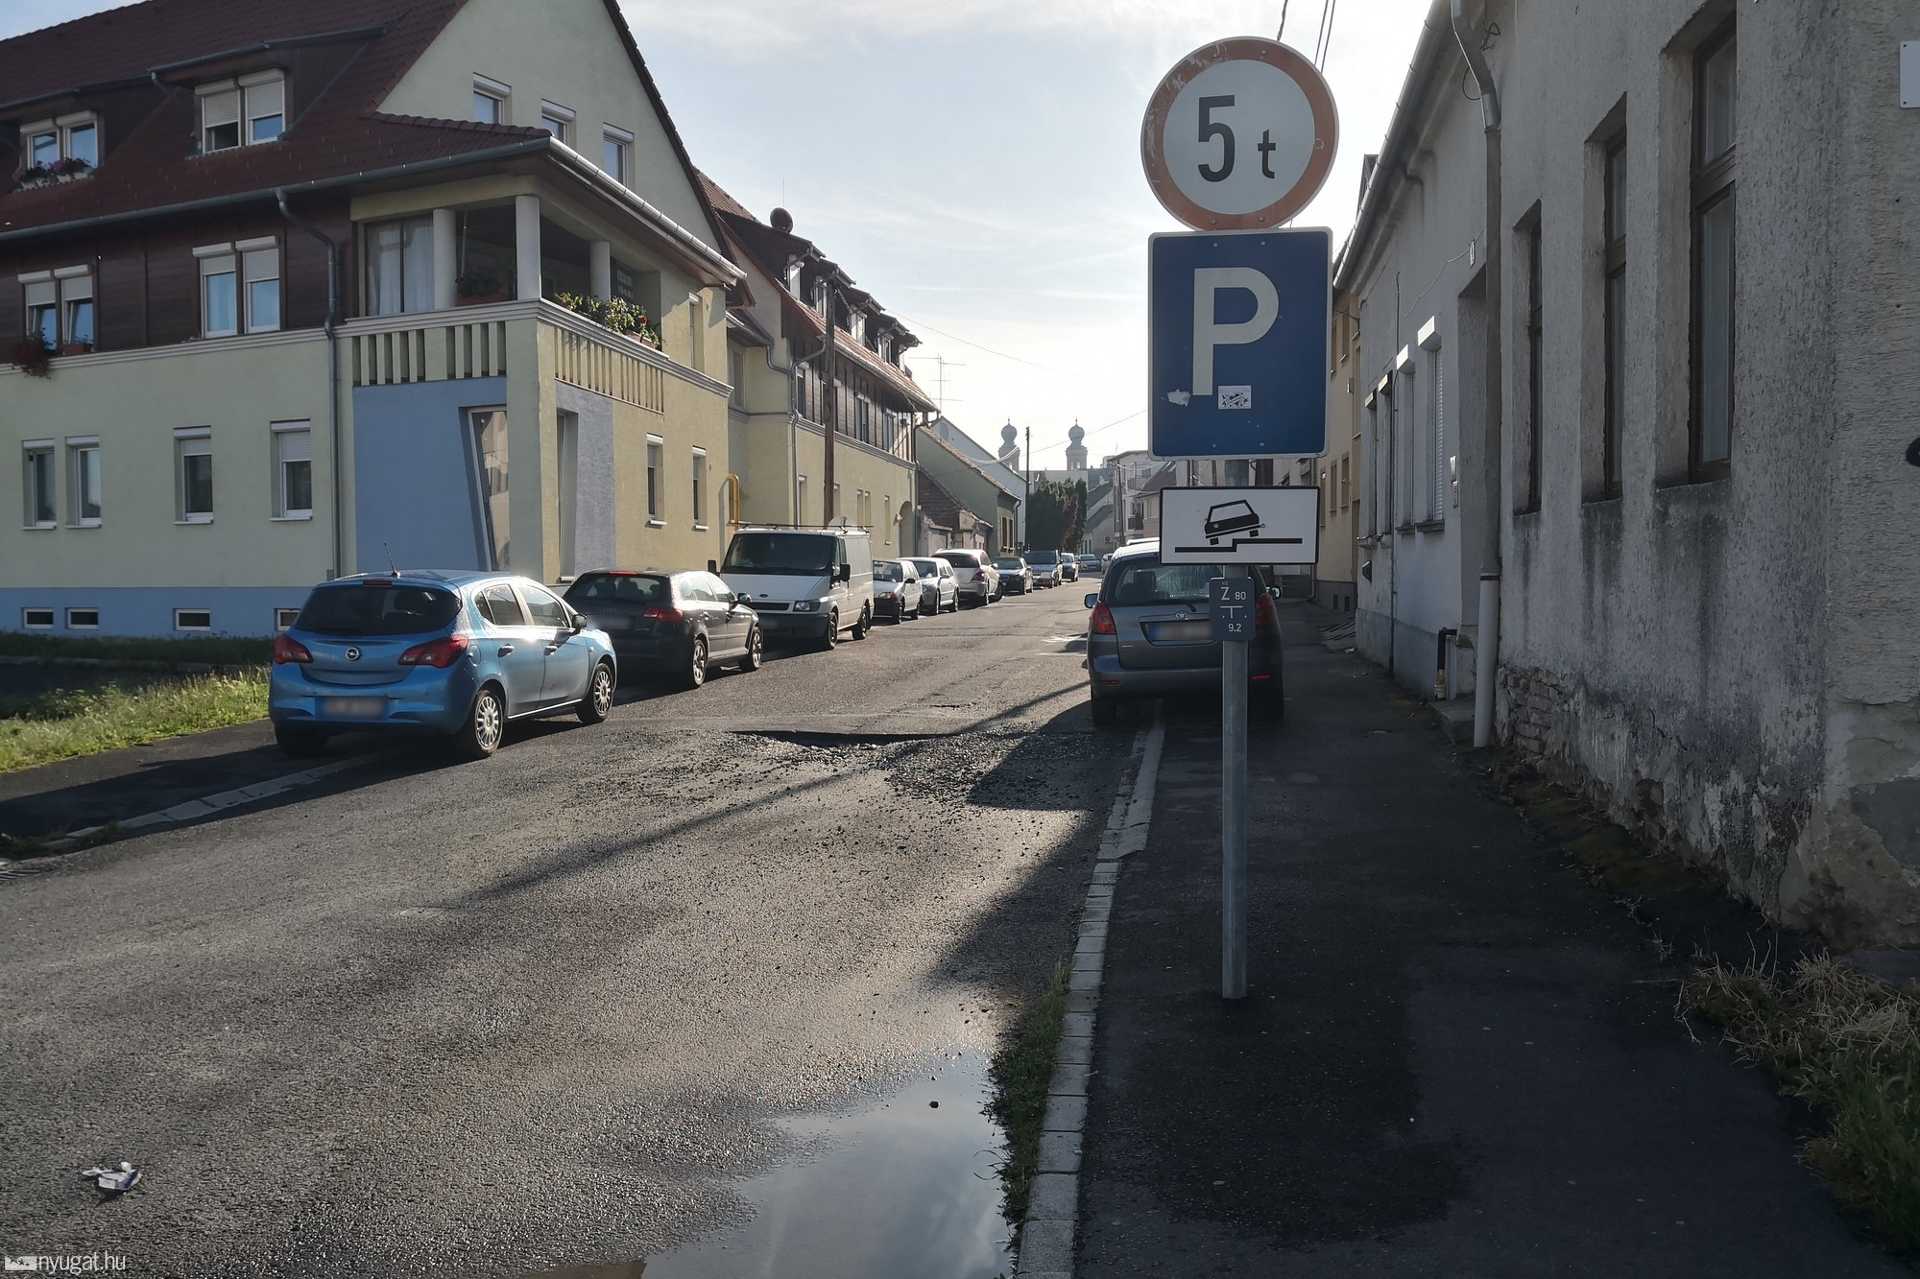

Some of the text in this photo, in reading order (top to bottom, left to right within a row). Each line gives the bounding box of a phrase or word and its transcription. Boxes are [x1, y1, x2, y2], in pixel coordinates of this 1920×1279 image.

[1198, 94, 1276, 182] 5 t
[1192, 267, 1279, 396] P
[1220, 586, 1230, 601] Z
